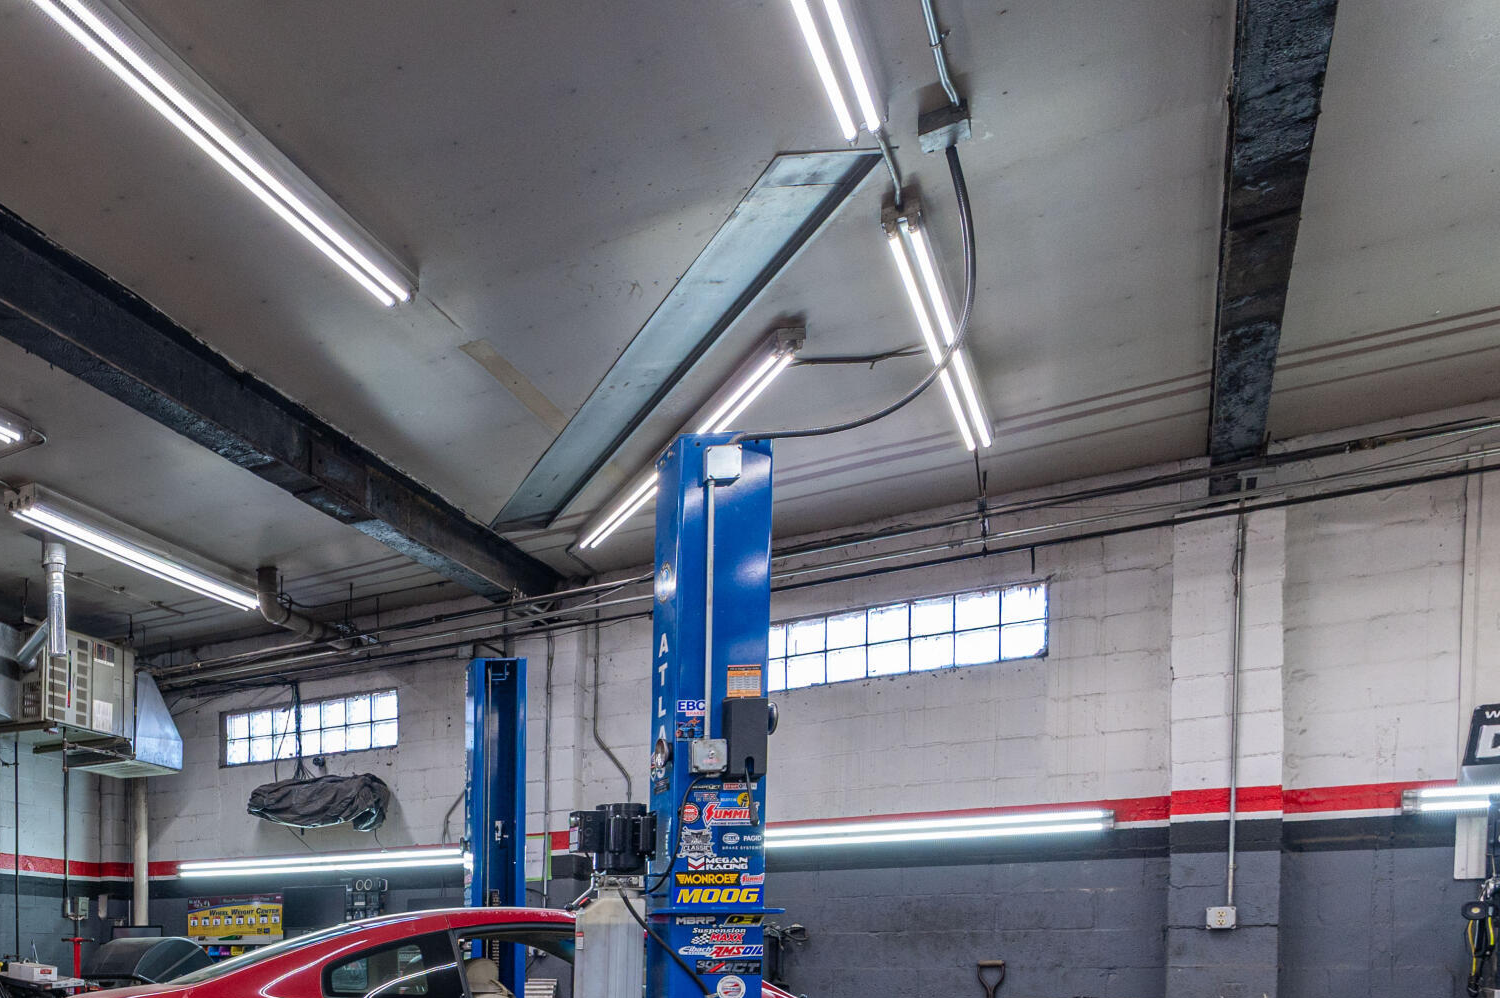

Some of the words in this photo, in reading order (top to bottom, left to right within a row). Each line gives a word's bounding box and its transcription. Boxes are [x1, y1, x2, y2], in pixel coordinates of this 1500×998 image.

[678, 701, 705, 711] EBC
[705, 804, 751, 822] SUMMI
[684, 873, 731, 885] MONROE
[676, 888, 760, 904] MOOG
[676, 916, 715, 925] MBRP
[709, 933, 745, 942] MAXX
[710, 945, 763, 958] AMSOIL
